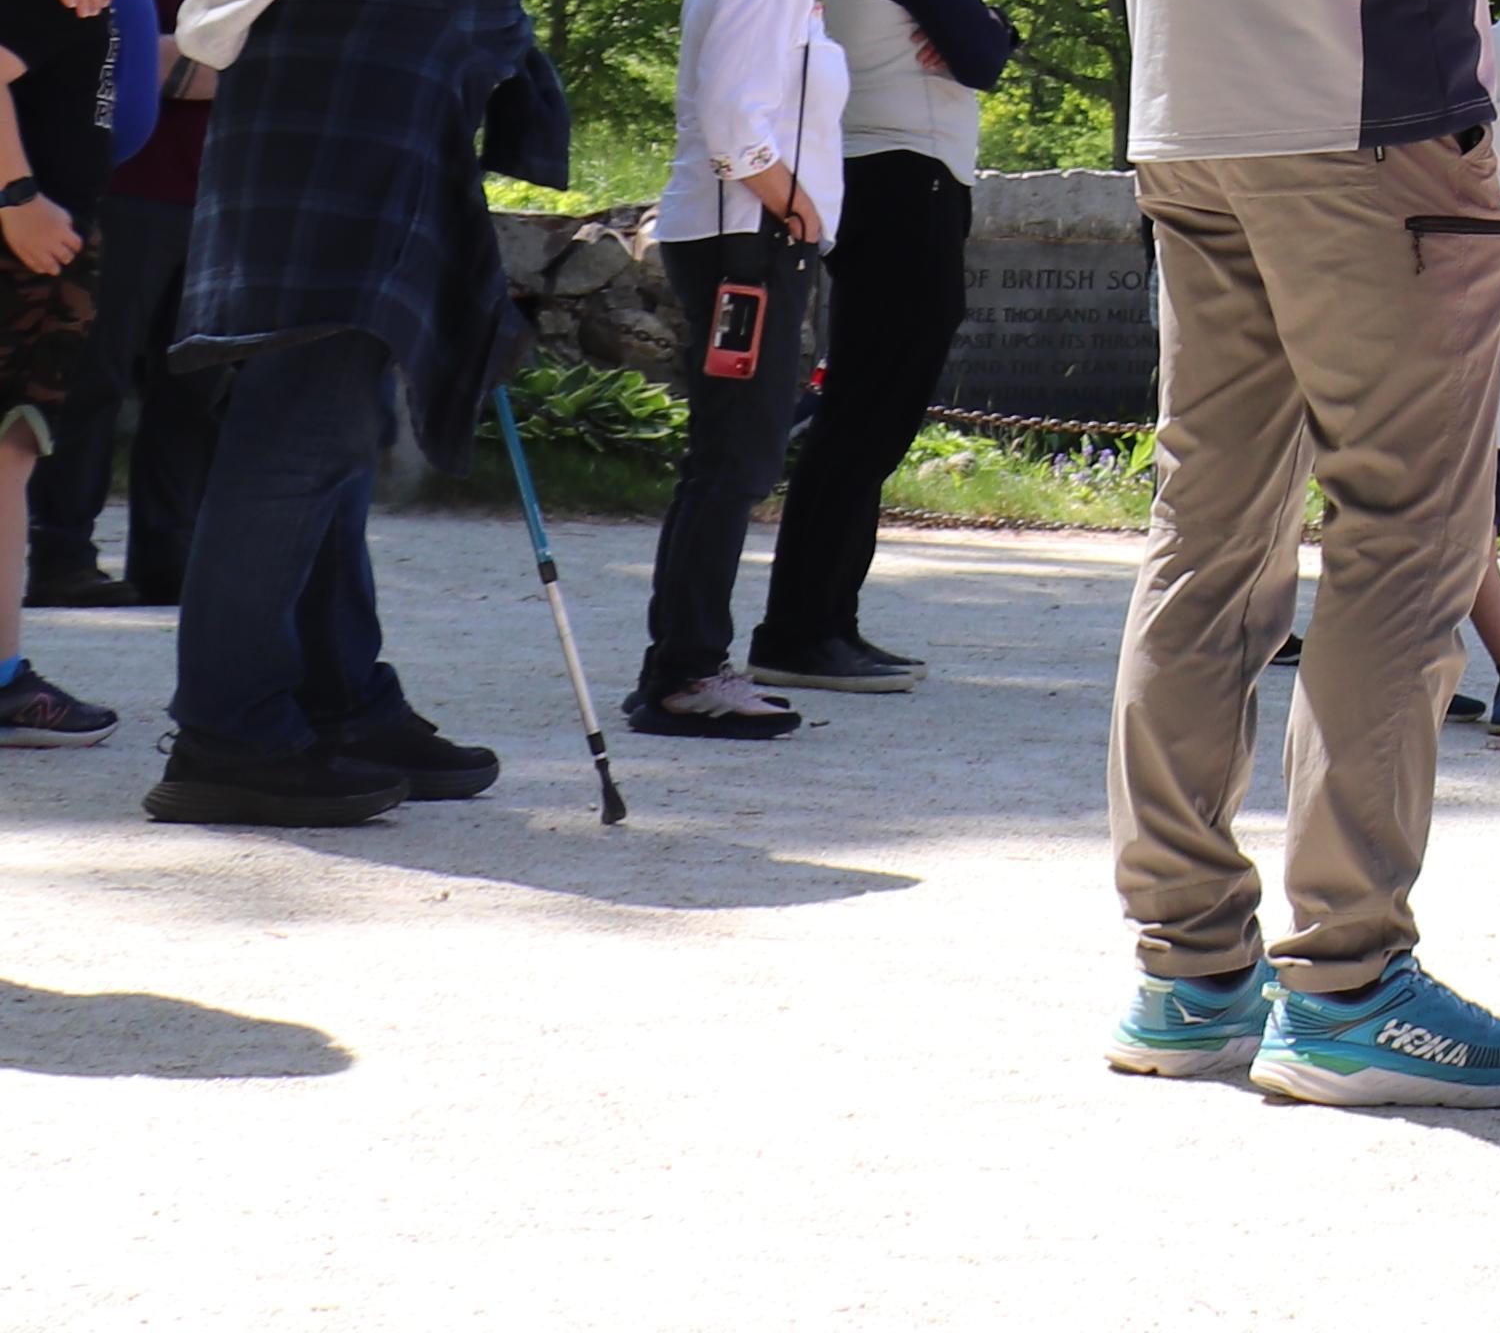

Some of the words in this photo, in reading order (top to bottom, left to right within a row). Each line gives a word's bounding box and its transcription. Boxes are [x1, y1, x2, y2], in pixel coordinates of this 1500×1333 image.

[1001, 268, 1095, 290] BRITISH
[1003, 307, 1101, 324] THOUSAND
[1108, 308, 1151, 324] MILE
[1001, 333, 1054, 350] UPON
[1059, 333, 1086, 350] ITS
[1090, 334, 1155, 350] THRON
[1376, 1018, 1469, 1068] HOKA
